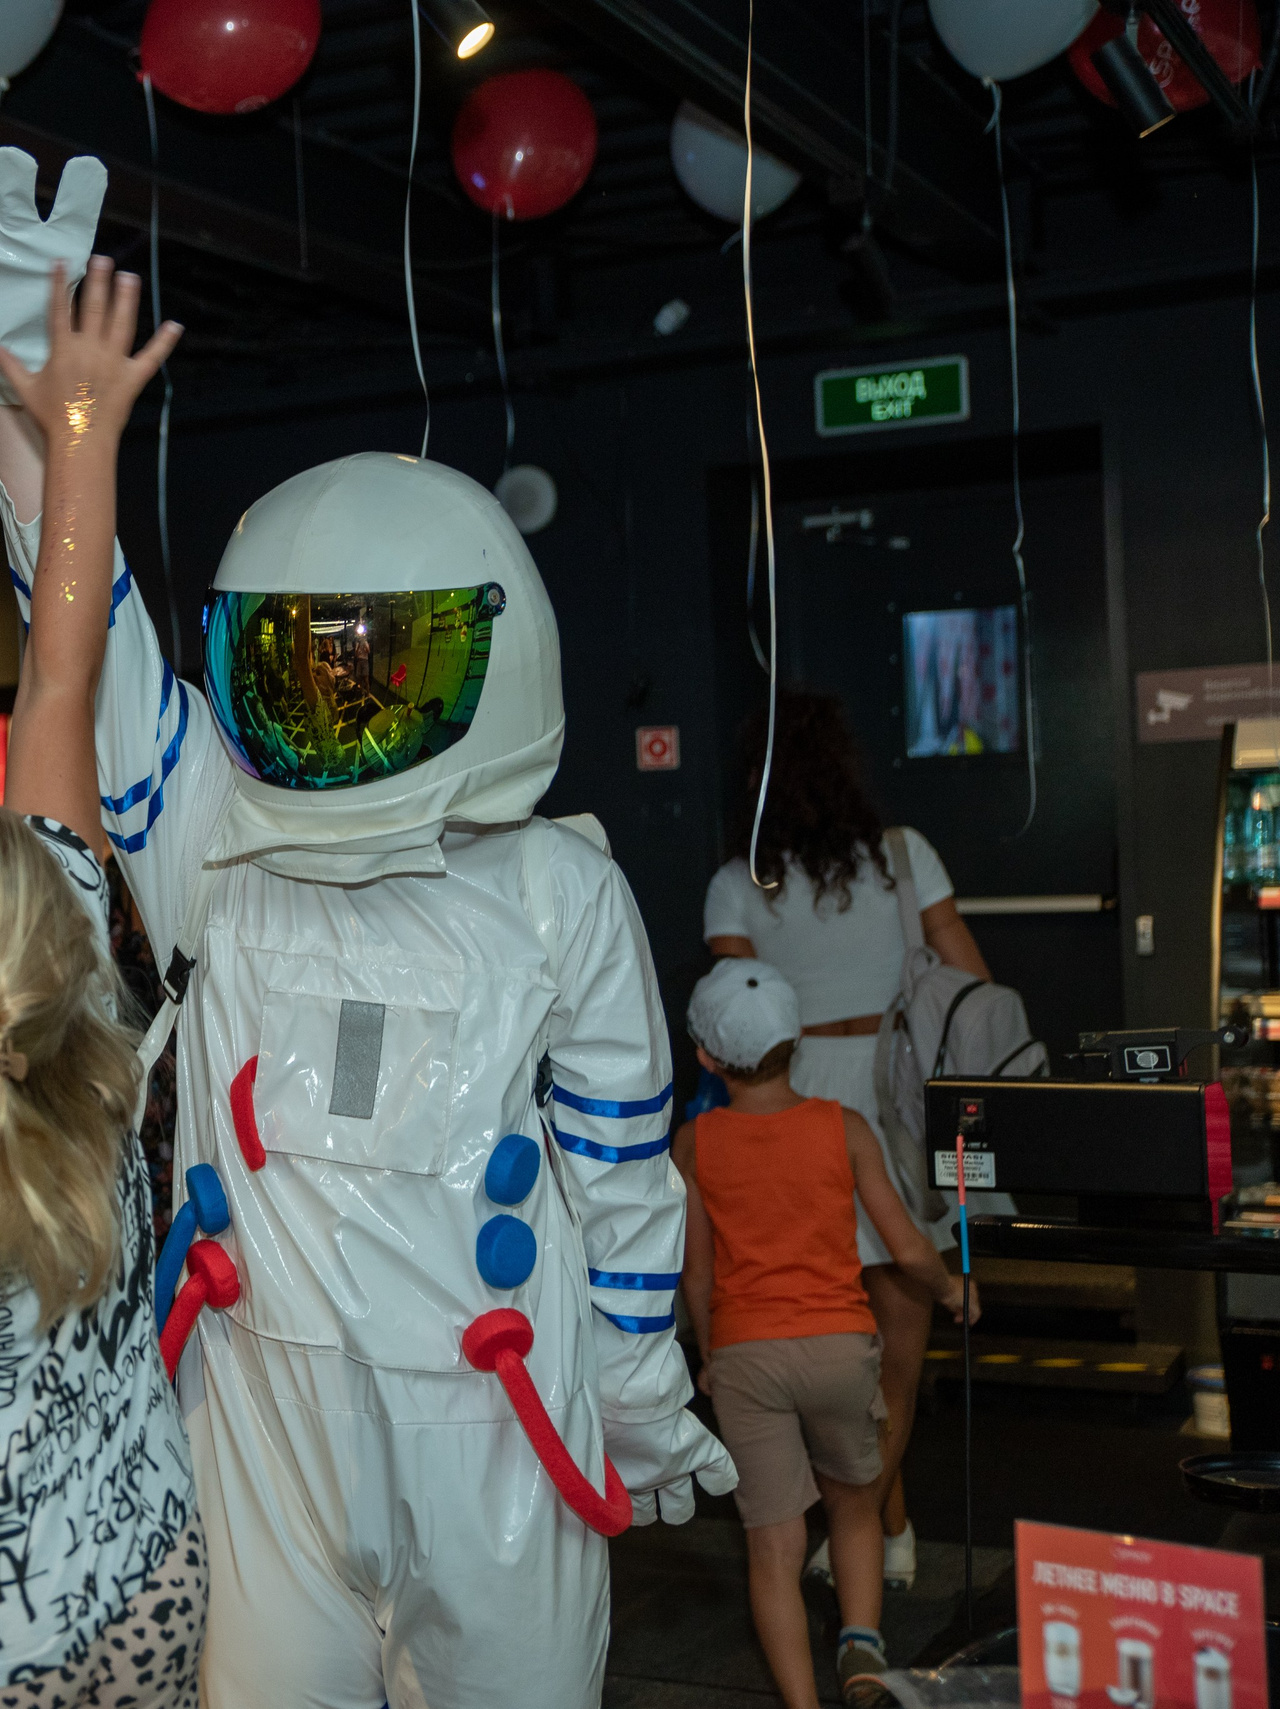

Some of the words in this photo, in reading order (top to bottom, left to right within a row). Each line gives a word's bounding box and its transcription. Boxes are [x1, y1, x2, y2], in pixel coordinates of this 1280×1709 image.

[855, 371, 927, 403] ВЫХОД
[871, 400, 914, 421] EXIT
[1099, 1571, 1157, 1605] МЕНЮ
[1177, 1583, 1239, 1620] SPACE
